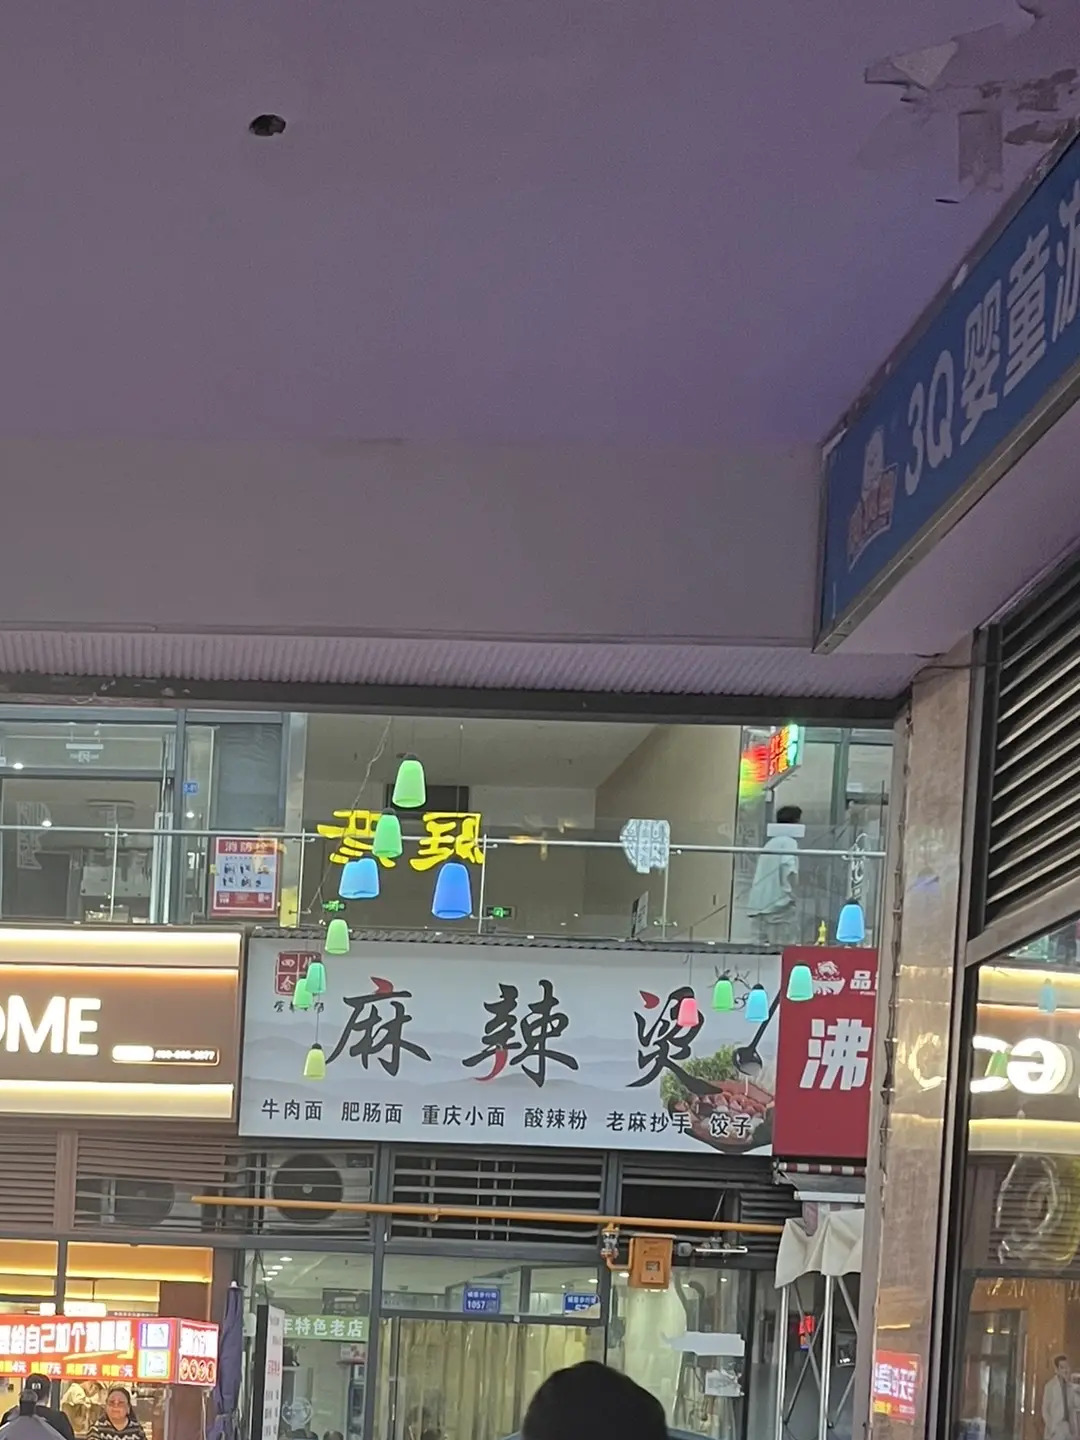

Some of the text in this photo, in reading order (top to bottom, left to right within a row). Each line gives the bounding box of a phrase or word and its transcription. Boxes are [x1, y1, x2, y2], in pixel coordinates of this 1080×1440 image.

[325, 977, 723, 1093] 麻辣烫
[261, 1099, 752, 1137] 牛肉面 肥肠面 重庆小面 酸辣粉 老麻抄手 饺子
